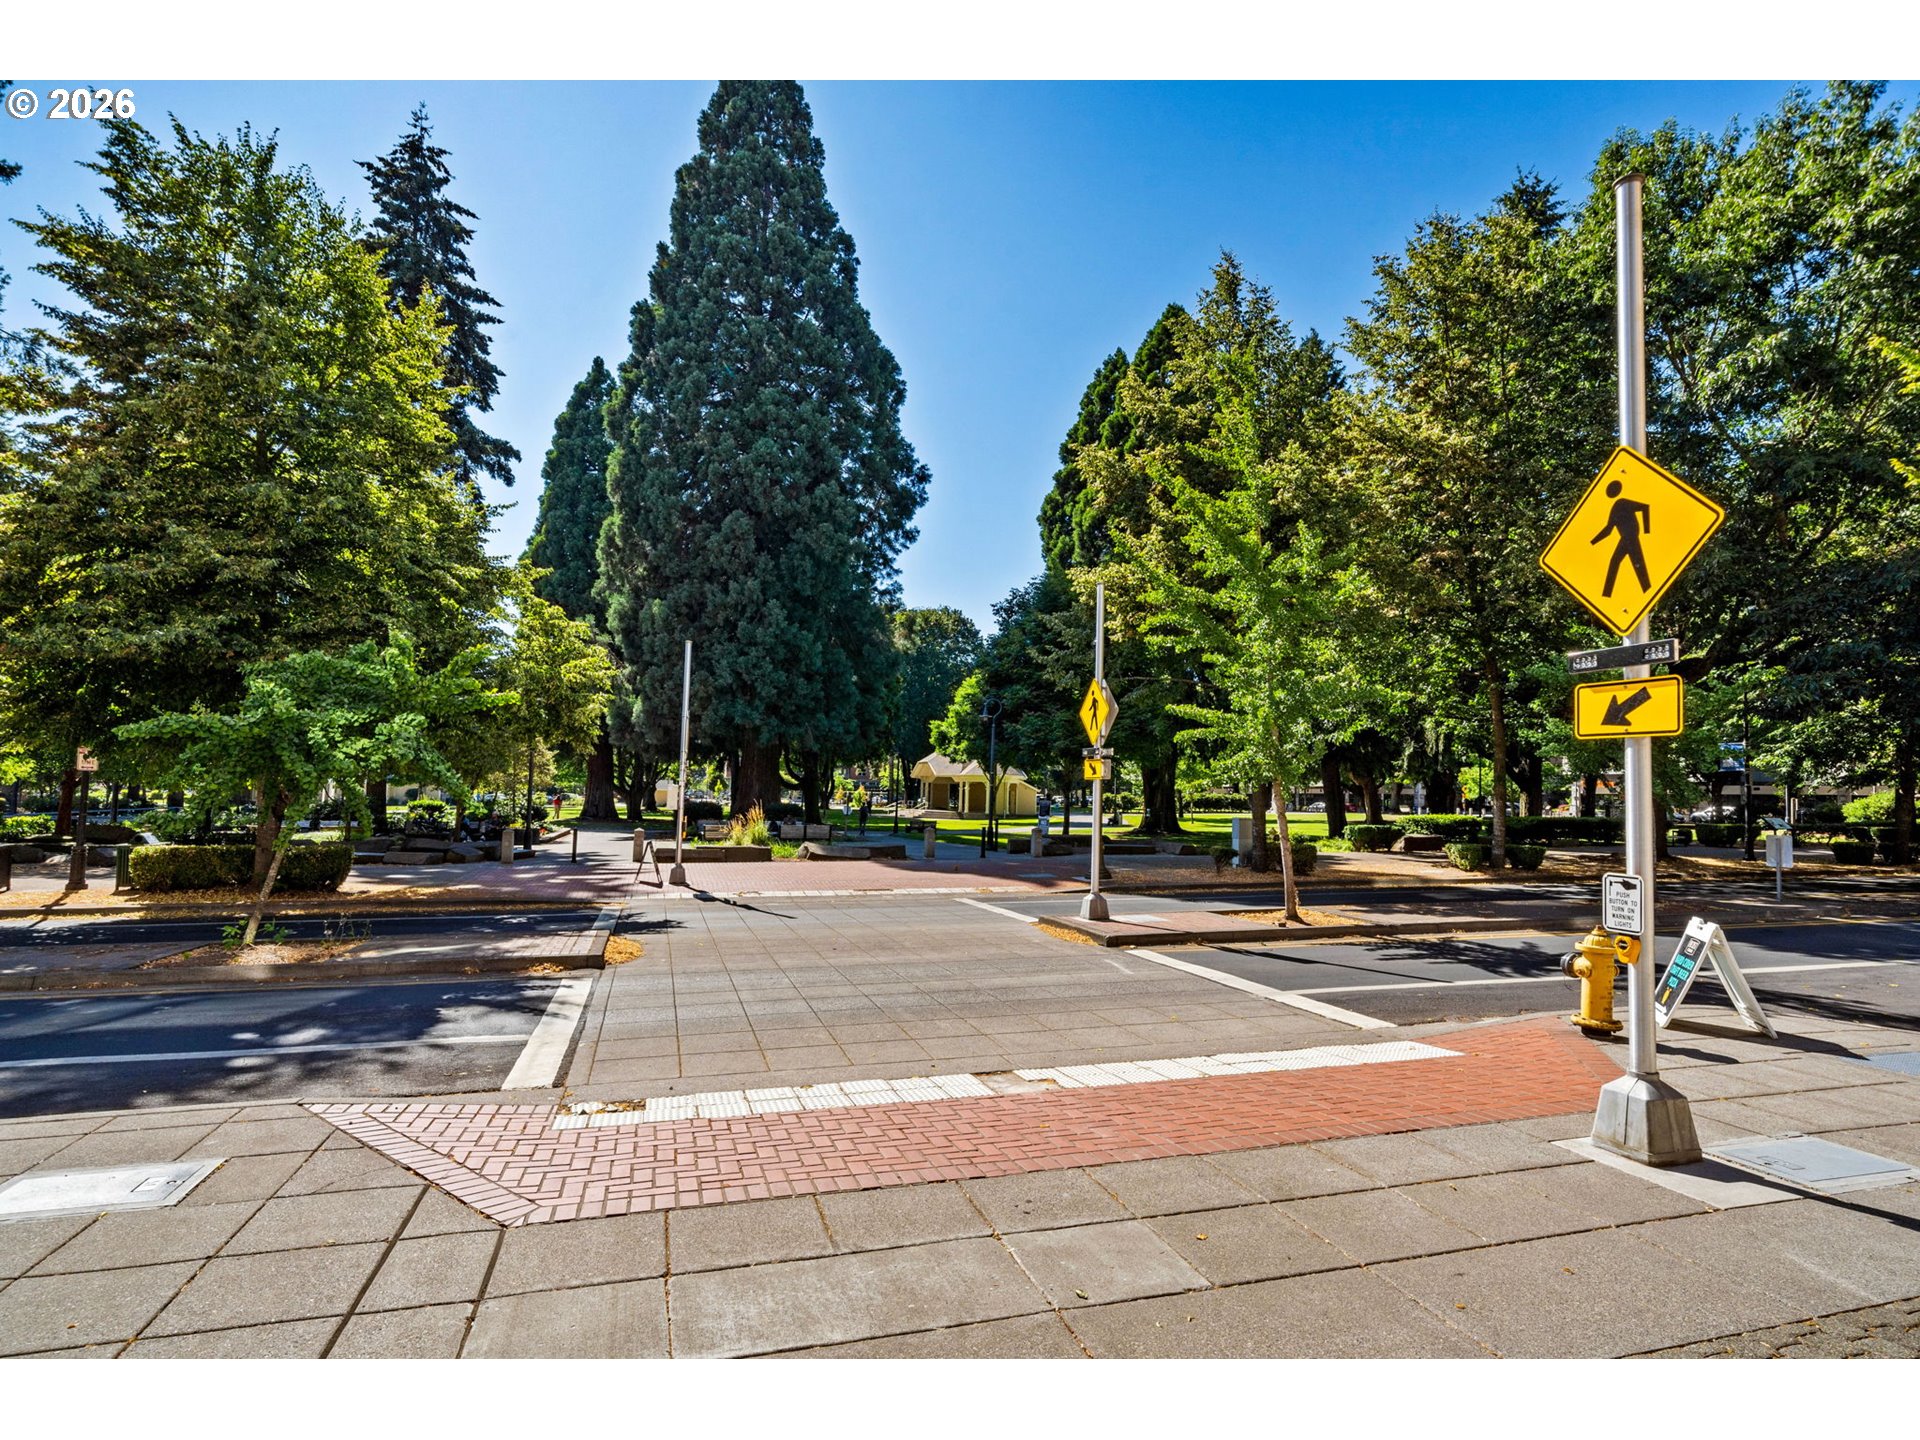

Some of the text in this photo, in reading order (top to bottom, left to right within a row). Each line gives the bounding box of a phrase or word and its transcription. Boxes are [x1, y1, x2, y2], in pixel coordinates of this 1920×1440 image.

[1616, 891, 1630, 899] PUSH
[1609, 897, 1628, 906] BUTTON
[1611, 905, 1625, 913] TURN
[1612, 913, 1635, 921] WARNING
[1614, 920, 1632, 929] LIGHTS
